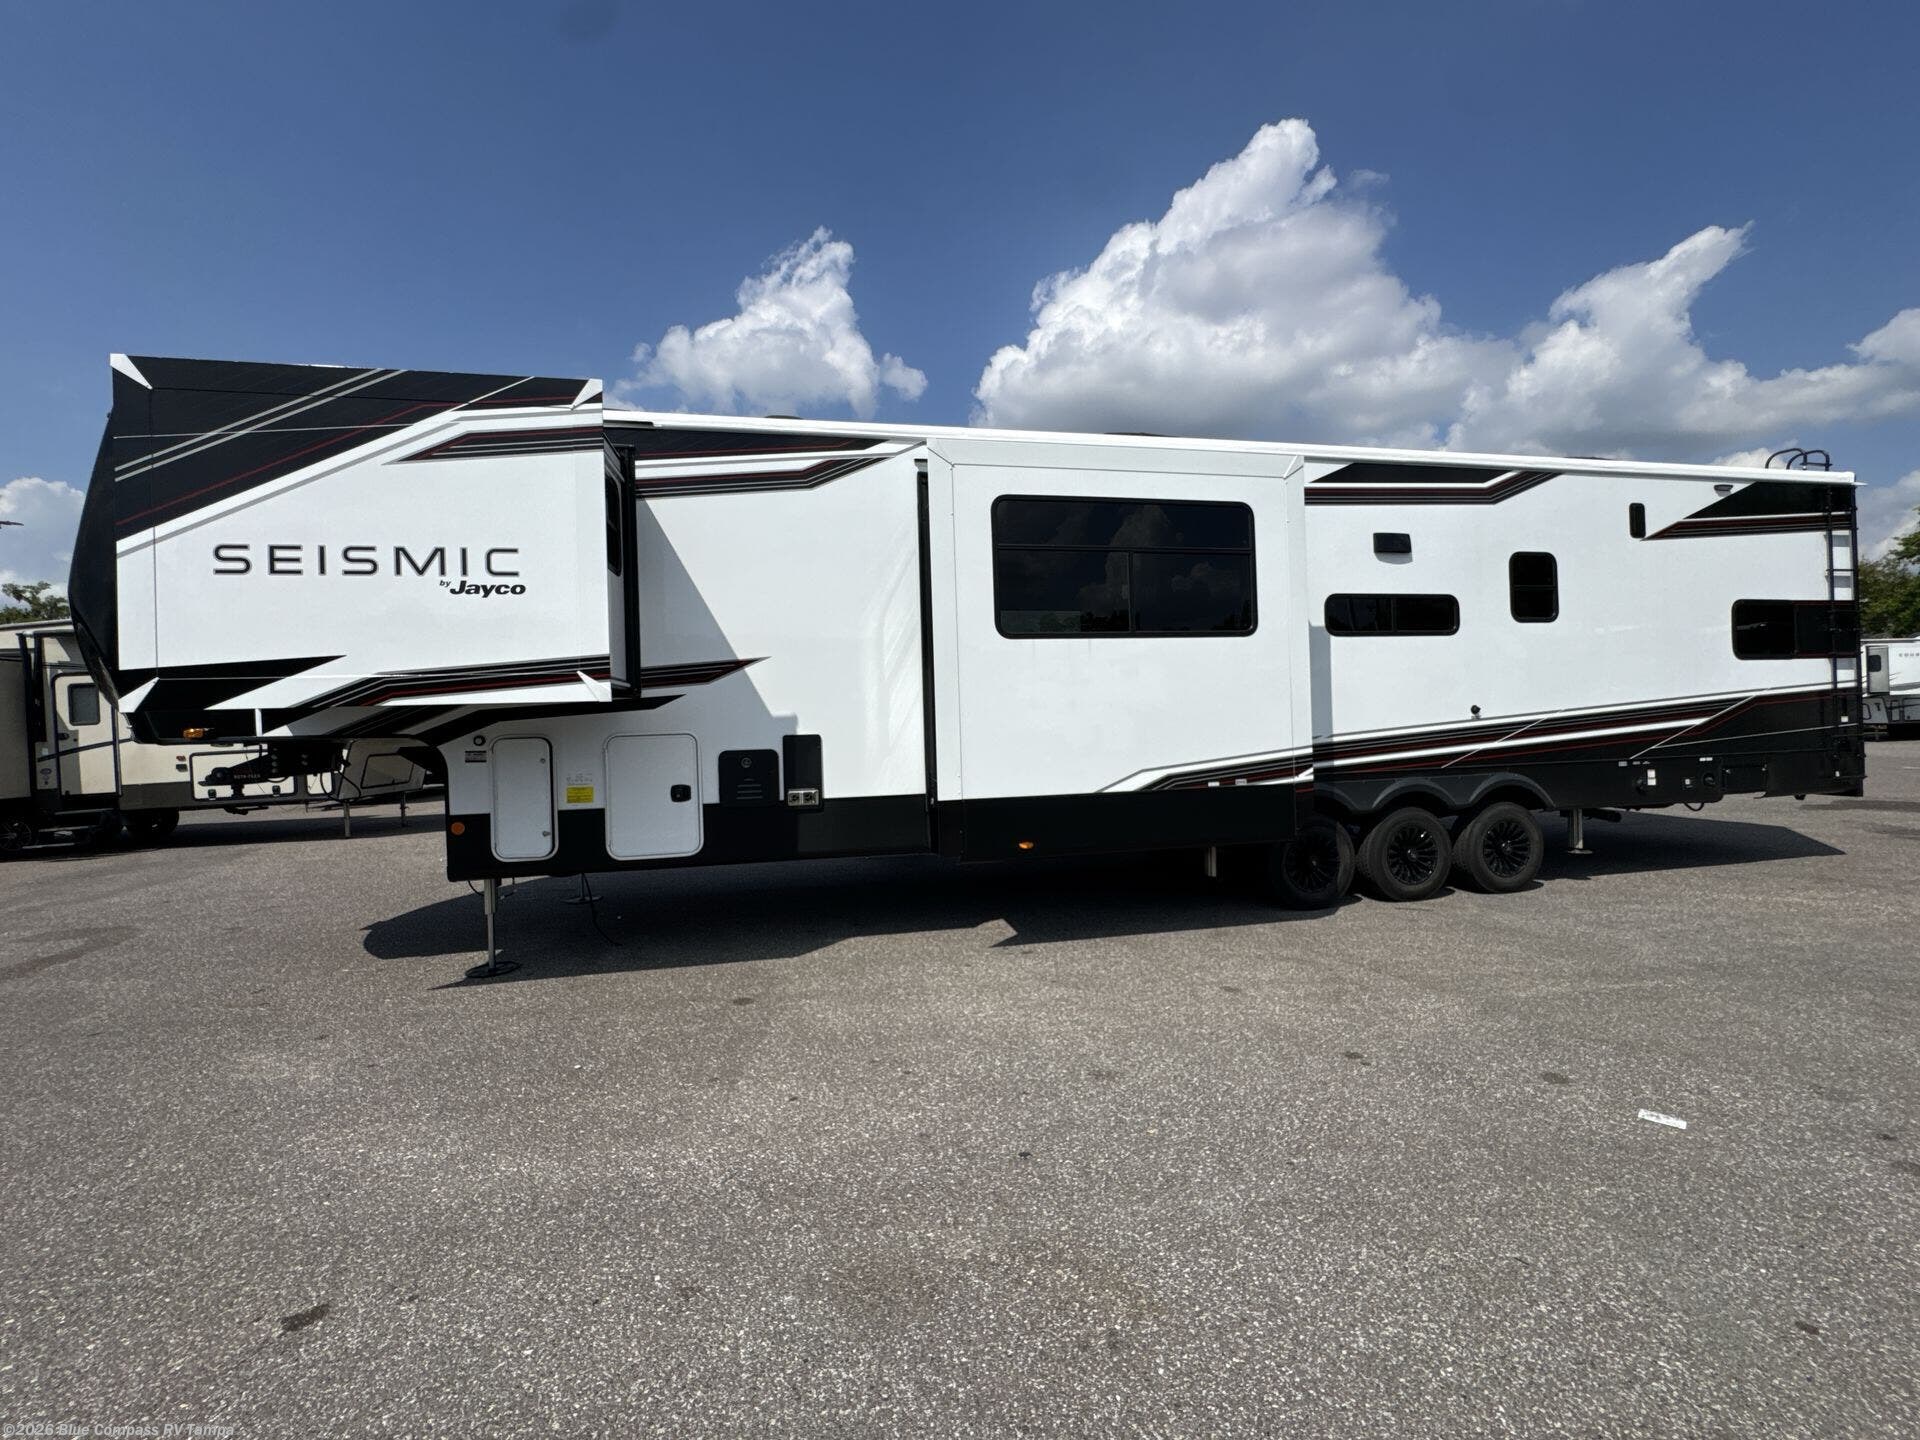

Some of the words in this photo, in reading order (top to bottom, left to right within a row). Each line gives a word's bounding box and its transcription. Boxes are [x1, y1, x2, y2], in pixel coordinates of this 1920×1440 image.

[213, 544, 520, 577] SEISMIC
[439, 579, 451, 588] by
[449, 580, 526, 599] Jayco
